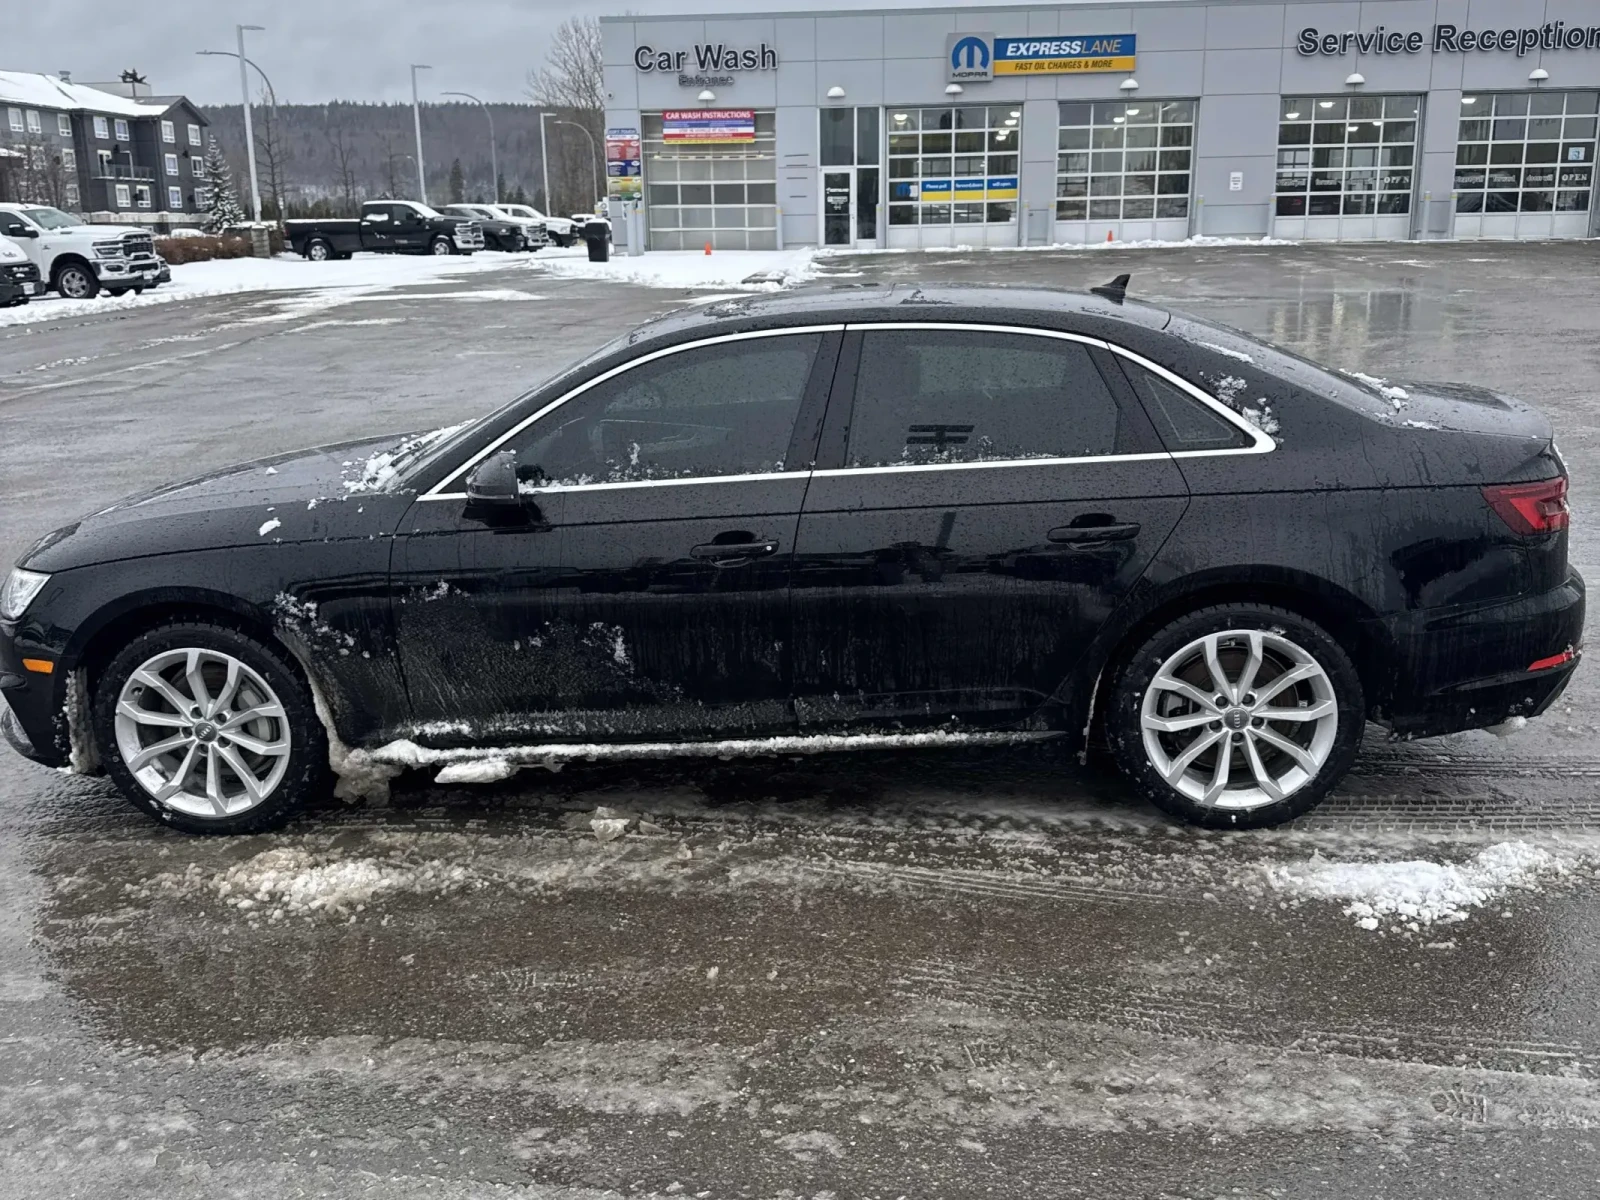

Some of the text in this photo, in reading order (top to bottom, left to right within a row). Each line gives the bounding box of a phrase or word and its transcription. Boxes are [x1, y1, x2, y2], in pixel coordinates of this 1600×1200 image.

[1298, 22, 1600, 56] Service Reception
[1006, 39, 1122, 56] EXPRESSLANE
[634, 43, 778, 72] Car Wash
[1014, 60, 1112, 71] FAST OIL CHANGES & MORE
[678, 74, 735, 86] Entrance
[681, 111, 701, 119] WASH
[702, 110, 751, 119] INSTRUCTIONS
[1561, 173, 1588, 181] OPEN
